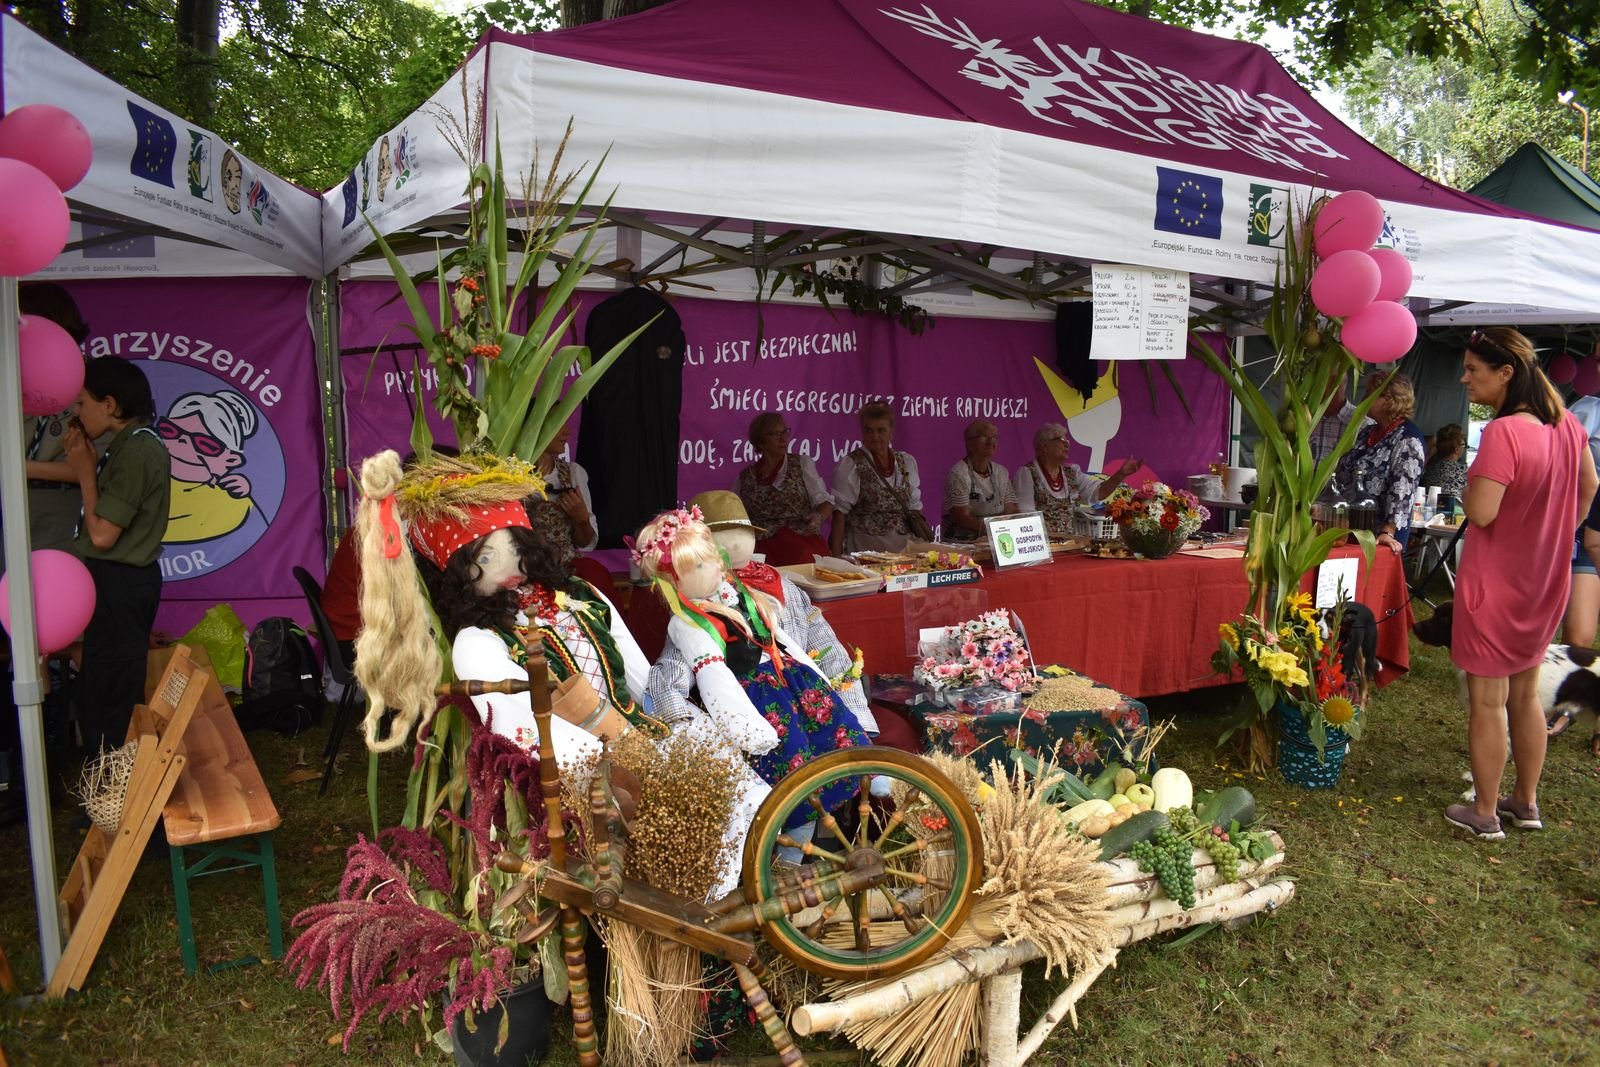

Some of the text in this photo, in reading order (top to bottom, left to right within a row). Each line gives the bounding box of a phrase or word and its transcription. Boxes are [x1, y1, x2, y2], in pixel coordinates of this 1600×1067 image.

[1187, 244, 1213, 256] Fundusz
[1215, 249, 1232, 260] Rolny
[1243, 254, 1259, 263] rzecz
[80, 330, 283, 407] arzyszenie
[1018, 544, 1045, 555] WIEJSKICH
[931, 571, 972, 584] LECH FREE
